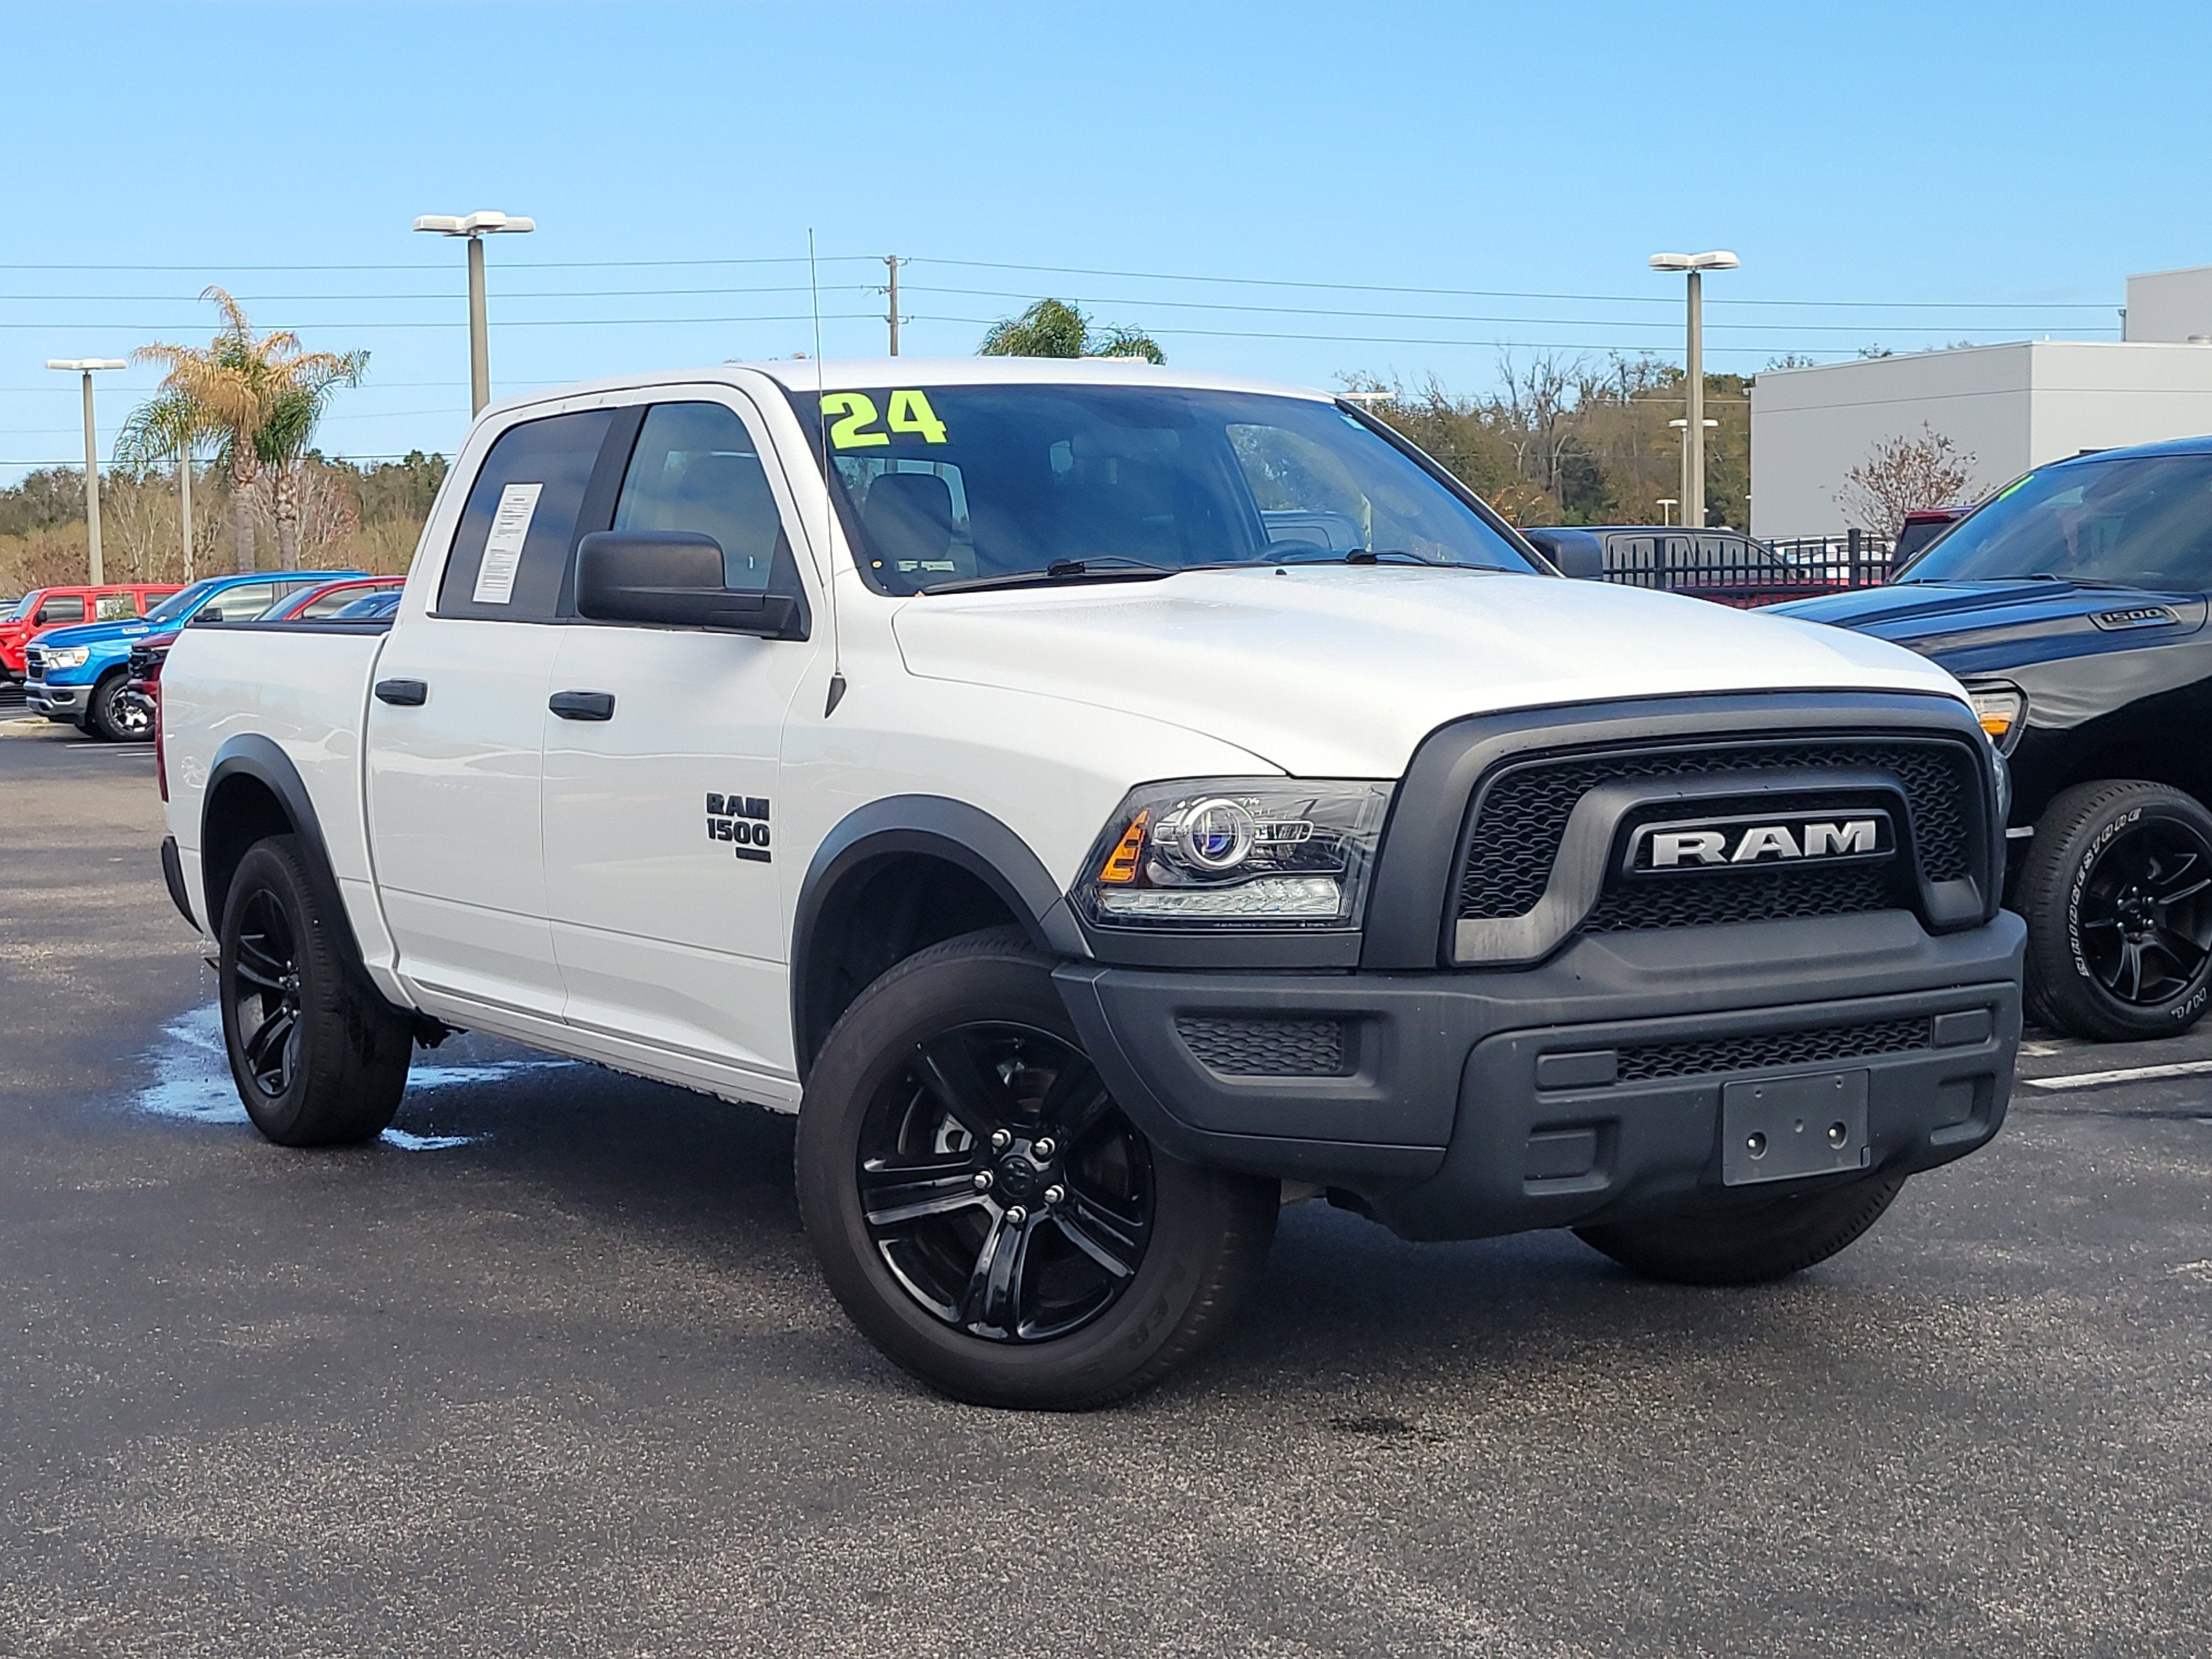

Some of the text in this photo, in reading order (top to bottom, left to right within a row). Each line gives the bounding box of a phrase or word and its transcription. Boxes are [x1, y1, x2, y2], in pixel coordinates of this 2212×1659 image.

[819, 390, 947, 449] 24
[2103, 609, 2160, 622] 1500
[707, 793, 770, 821] RAM
[707, 817, 770, 847] 1500
[1653, 820, 1876, 867] RAM
